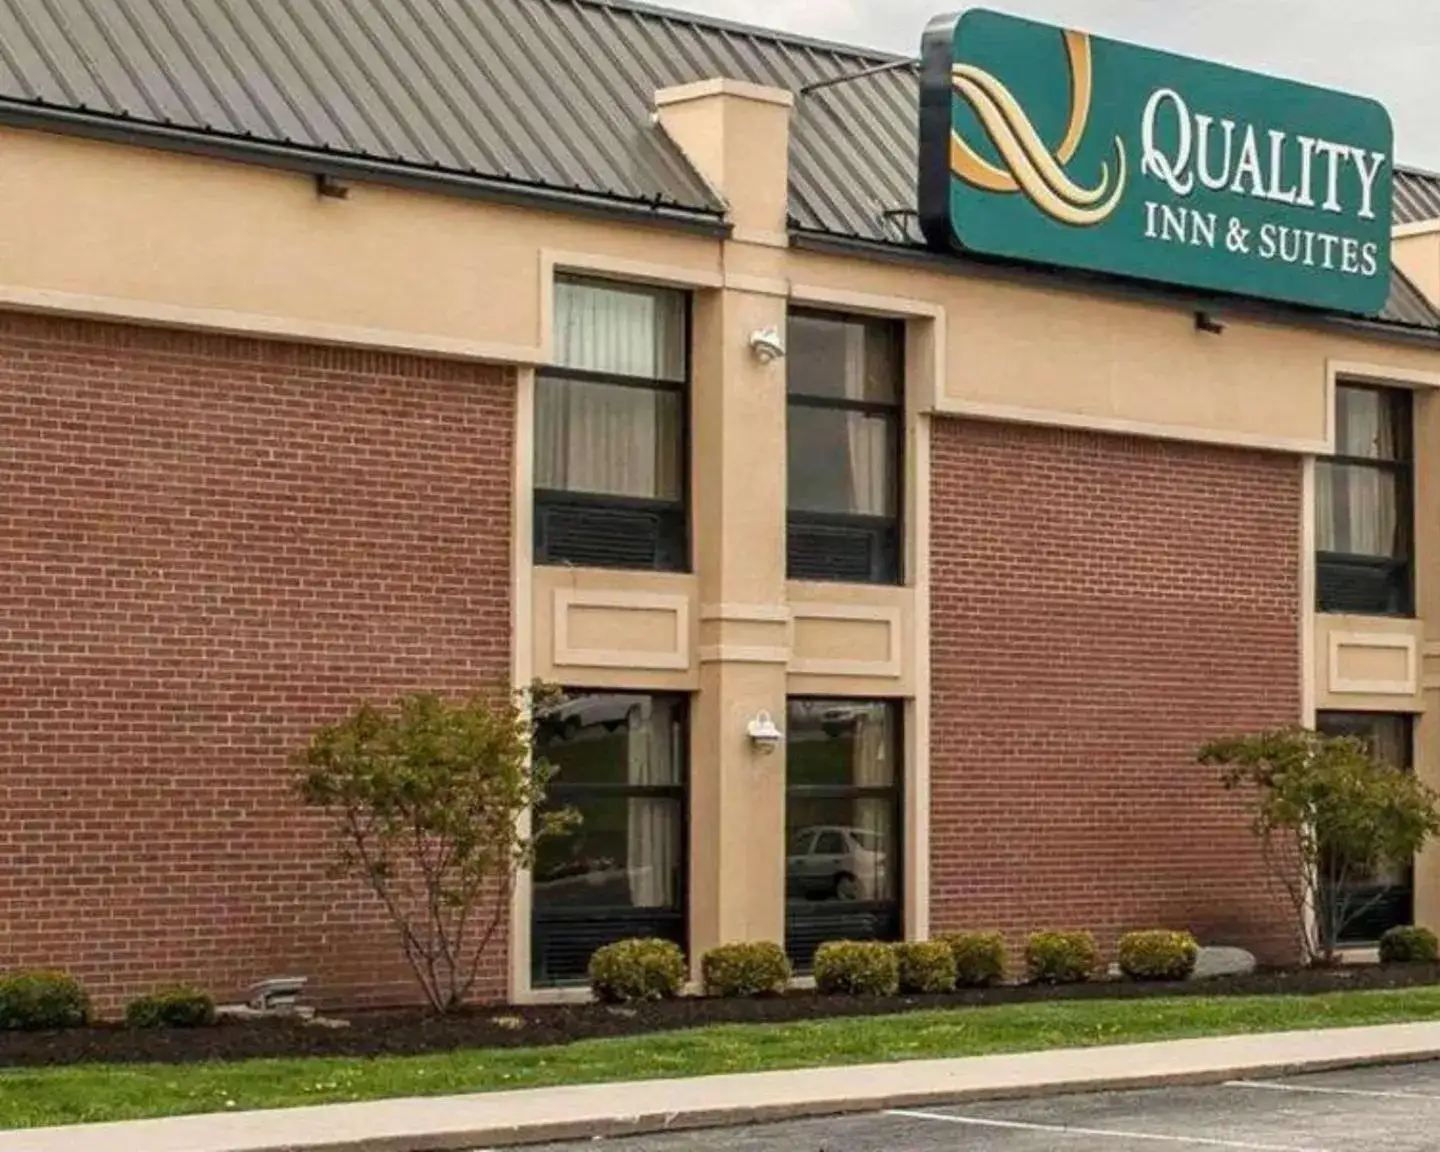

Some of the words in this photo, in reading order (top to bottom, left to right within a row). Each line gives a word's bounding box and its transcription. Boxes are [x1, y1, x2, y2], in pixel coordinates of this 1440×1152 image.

[1142, 89, 1384, 219] QUALITY
[1144, 202, 1216, 247] INN
[1226, 217, 1249, 255] &
[1259, 224, 1377, 276] SUITES
